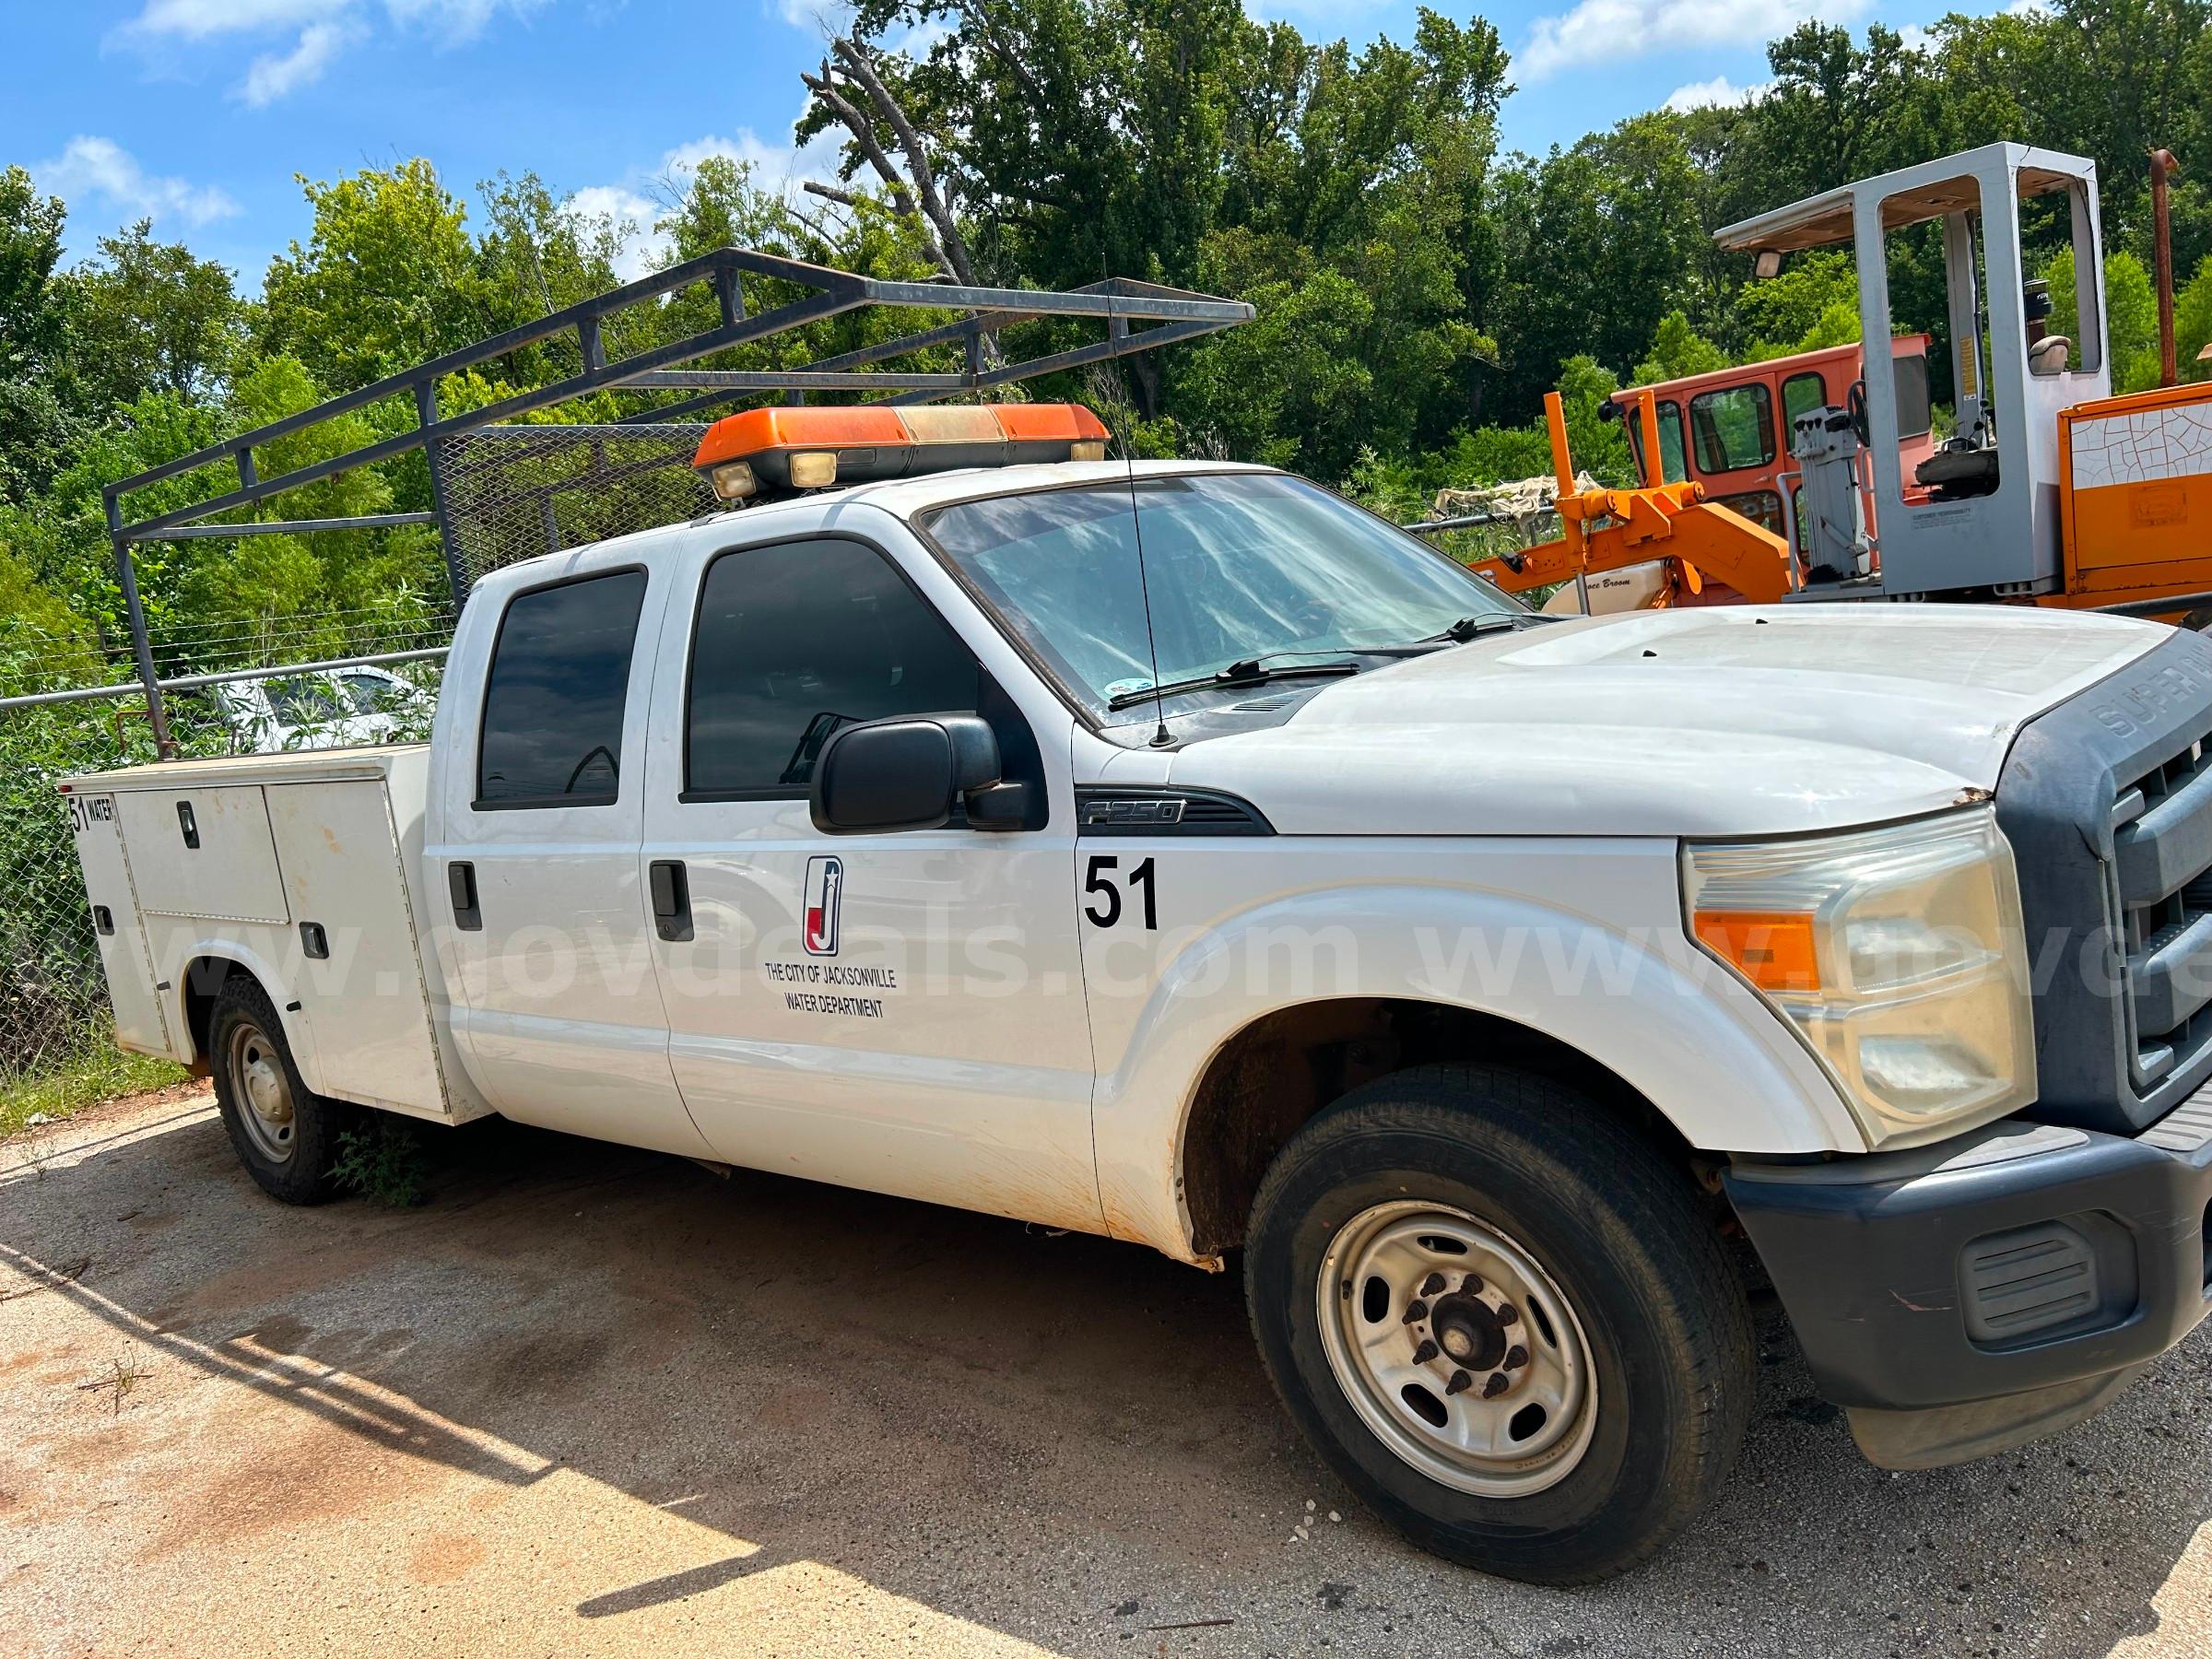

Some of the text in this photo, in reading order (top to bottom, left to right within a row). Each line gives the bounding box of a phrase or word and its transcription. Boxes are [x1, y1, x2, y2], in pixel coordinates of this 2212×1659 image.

[1602, 578, 1630, 589] Broom
[2088, 665, 2202, 738] SUPER
[67, 795, 113, 832] 51 WATER
[1085, 855, 1158, 930] 51
[765, 962, 897, 989] THE CITY OF JACKSONVILLE
[784, 992, 884, 1018] WATER DEPARTMENT
